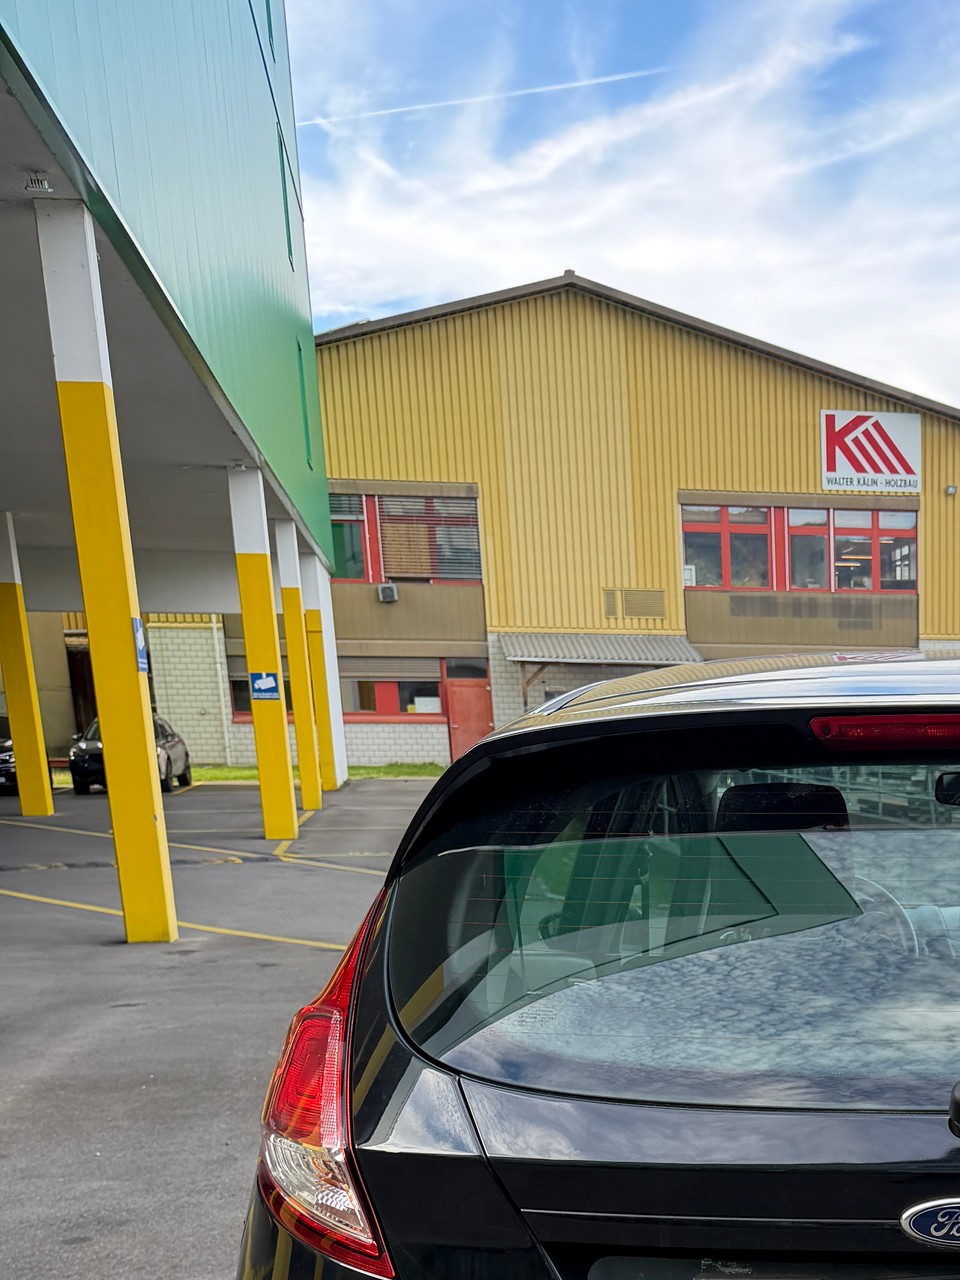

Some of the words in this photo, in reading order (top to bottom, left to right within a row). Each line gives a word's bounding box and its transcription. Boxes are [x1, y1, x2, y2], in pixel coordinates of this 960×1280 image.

[826, 476, 854, 487] WALTER
[857, 475, 878, 488] KÄLIN
[884, 478, 918, 489] HOLZBAU
